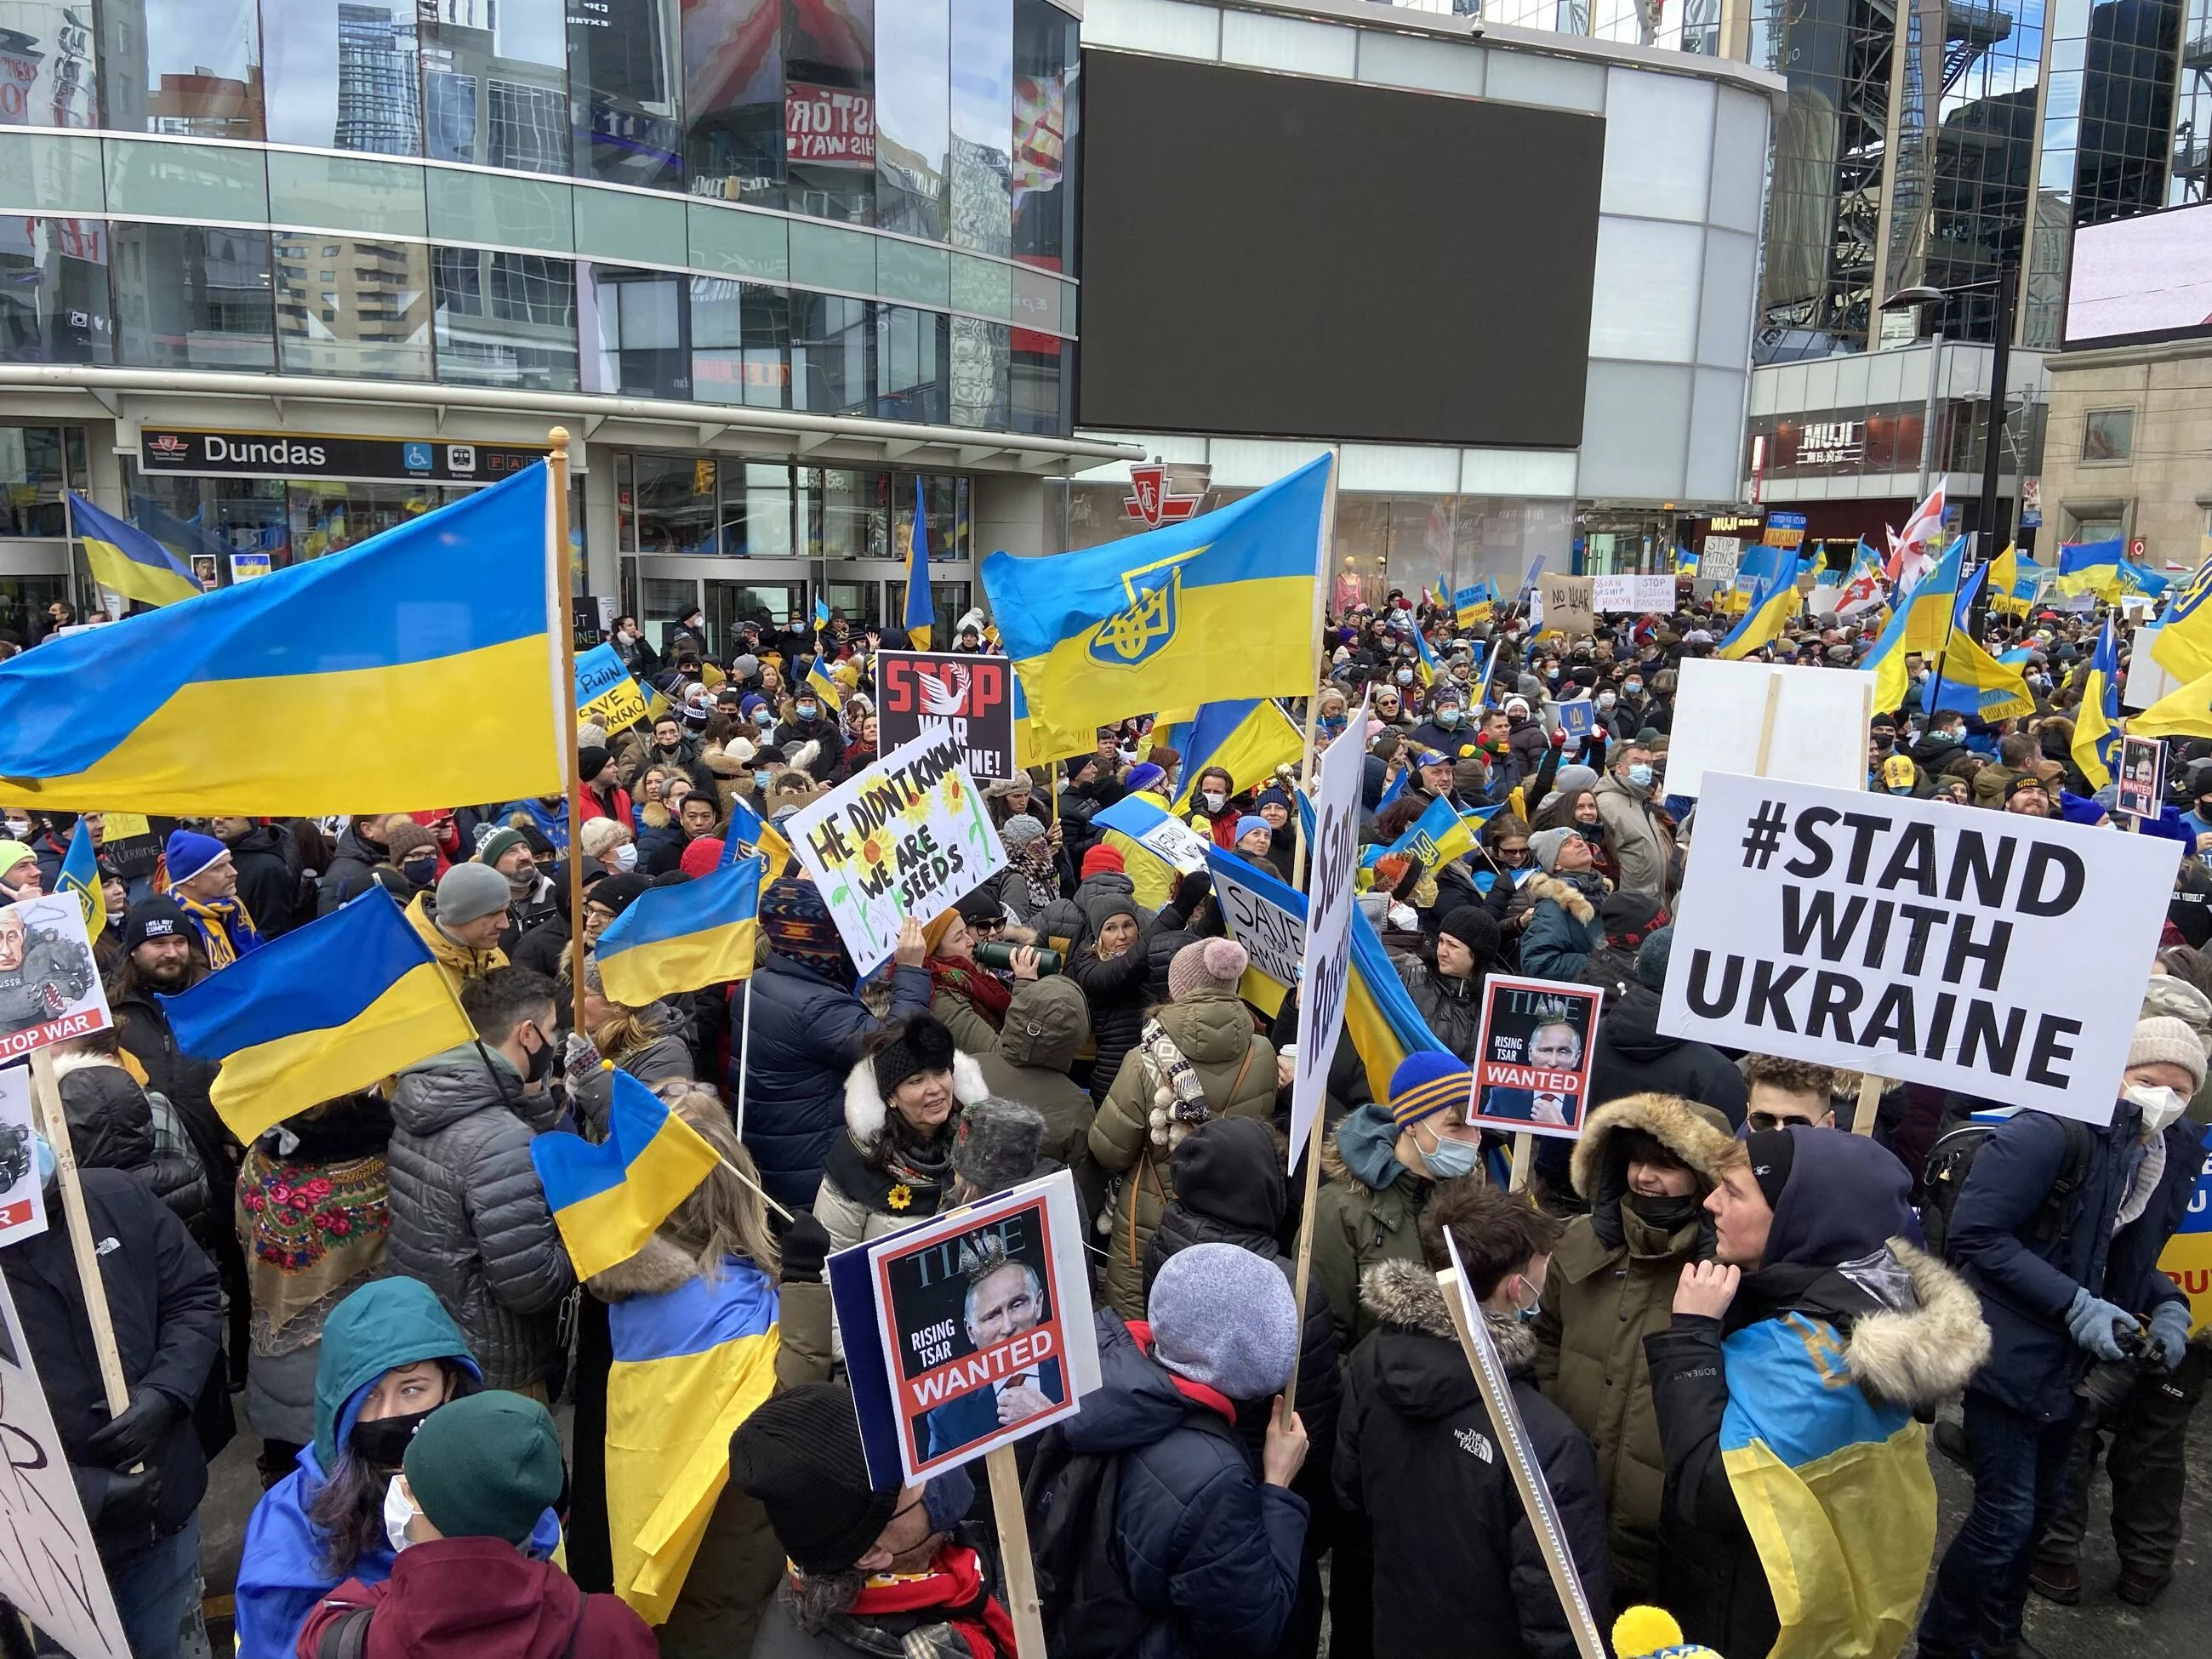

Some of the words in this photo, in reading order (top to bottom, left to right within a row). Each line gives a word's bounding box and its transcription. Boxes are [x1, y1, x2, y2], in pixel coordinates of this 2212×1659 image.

[1804, 422, 1852, 449] MUJI
[204, 436, 327, 465] Dundas
[1711, 516, 1737, 531] MUJI
[1708, 537, 1735, 551] STOP
[1595, 579, 1622, 588] SSIAN
[1643, 578, 1666, 587] STOP
[1552, 590, 1565, 605] NO
[887, 660, 1002, 718] STOP
[605, 694, 646, 732] MOCRACY
[2123, 780, 2152, 795] WANTED
[806, 812, 856, 873] HE
[846, 767, 912, 841] DIDN'T
[907, 736, 961, 794] KNOW
[858, 860, 894, 900] WE
[895, 824, 939, 875] ARE
[1741, 800, 2086, 917] #STAND
[900, 843, 964, 909] SEEDS
[1228, 886, 1304, 956] SAVE
[1782, 884, 2014, 992] WITH
[1685, 949, 2084, 1090] UKRAINE
[0, 1029, 39, 1054] TOP
[43, 1015, 89, 1040] WAR
[1494, 1035, 1523, 1050] RISING
[1497, 1048, 1517, 1062] TSAR
[1487, 1065, 1578, 1091] WANTED
[911, 1319, 955, 1352] RISING
[912, 1330, 1052, 1406] WANTED
[919, 1339, 953, 1368] TSAR
[1454, 1429, 1481, 1450] NORTH
[1460, 1440, 1479, 1456] FACE
[1468, 1428, 1483, 1442] THE
